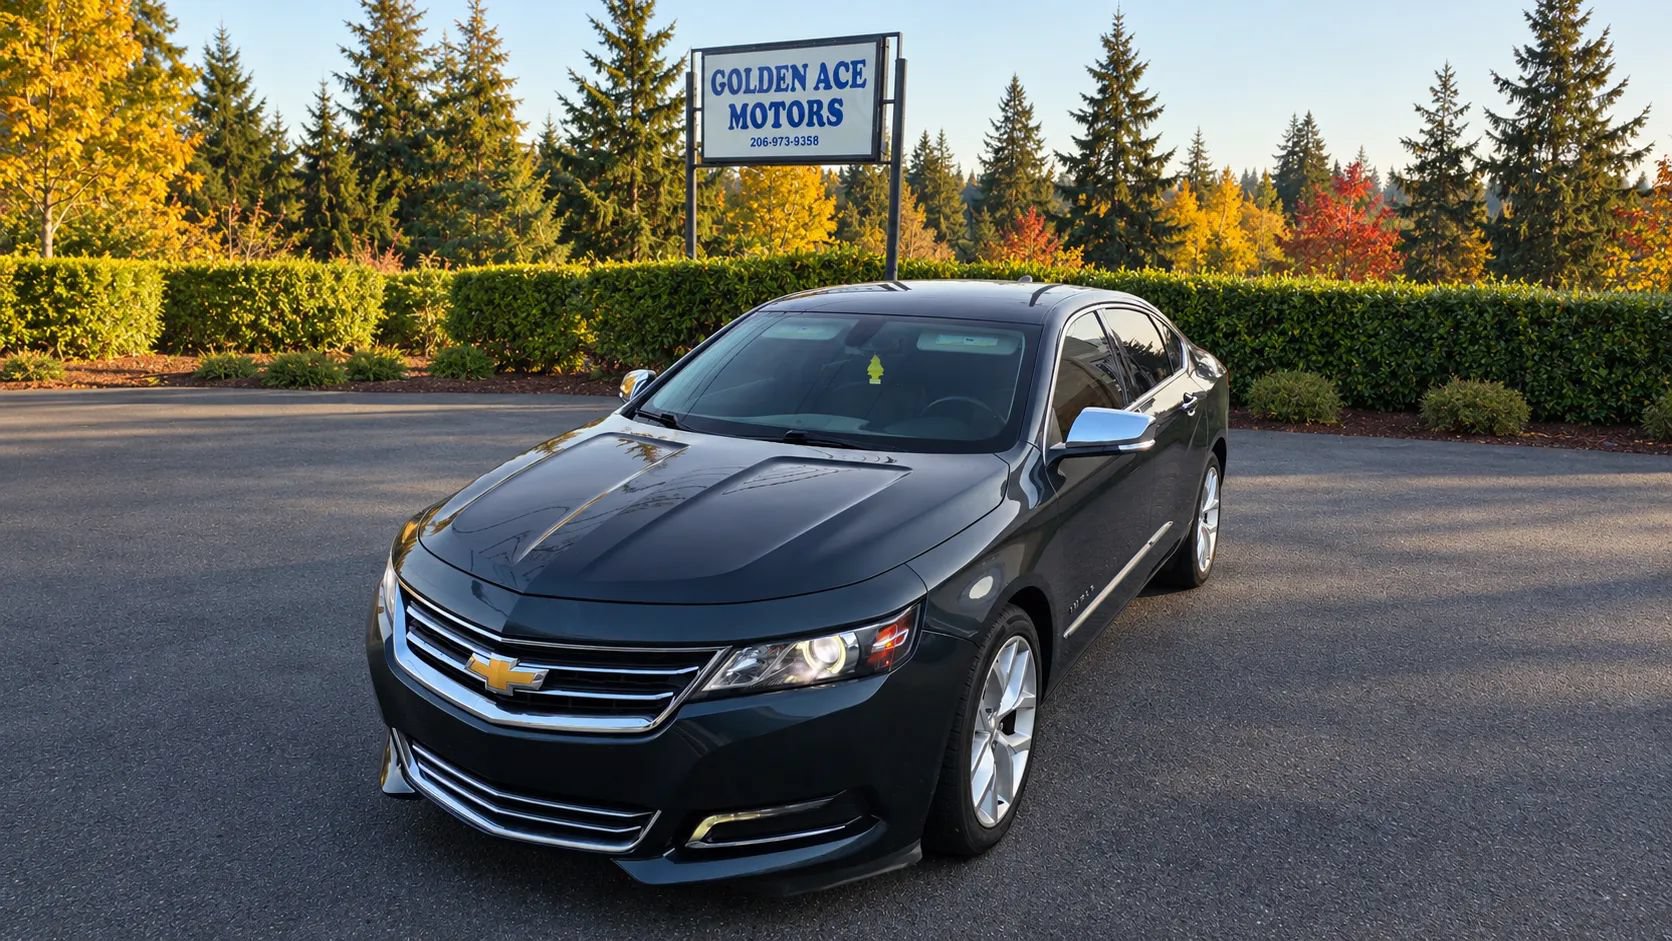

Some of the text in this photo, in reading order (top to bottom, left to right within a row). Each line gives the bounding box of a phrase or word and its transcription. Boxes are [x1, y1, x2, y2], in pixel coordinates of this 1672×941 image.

[711, 59, 867, 96] GOLDEN ACE
[728, 98, 843, 130] MOTORS
[750, 135, 819, 147] 206-973-9358
